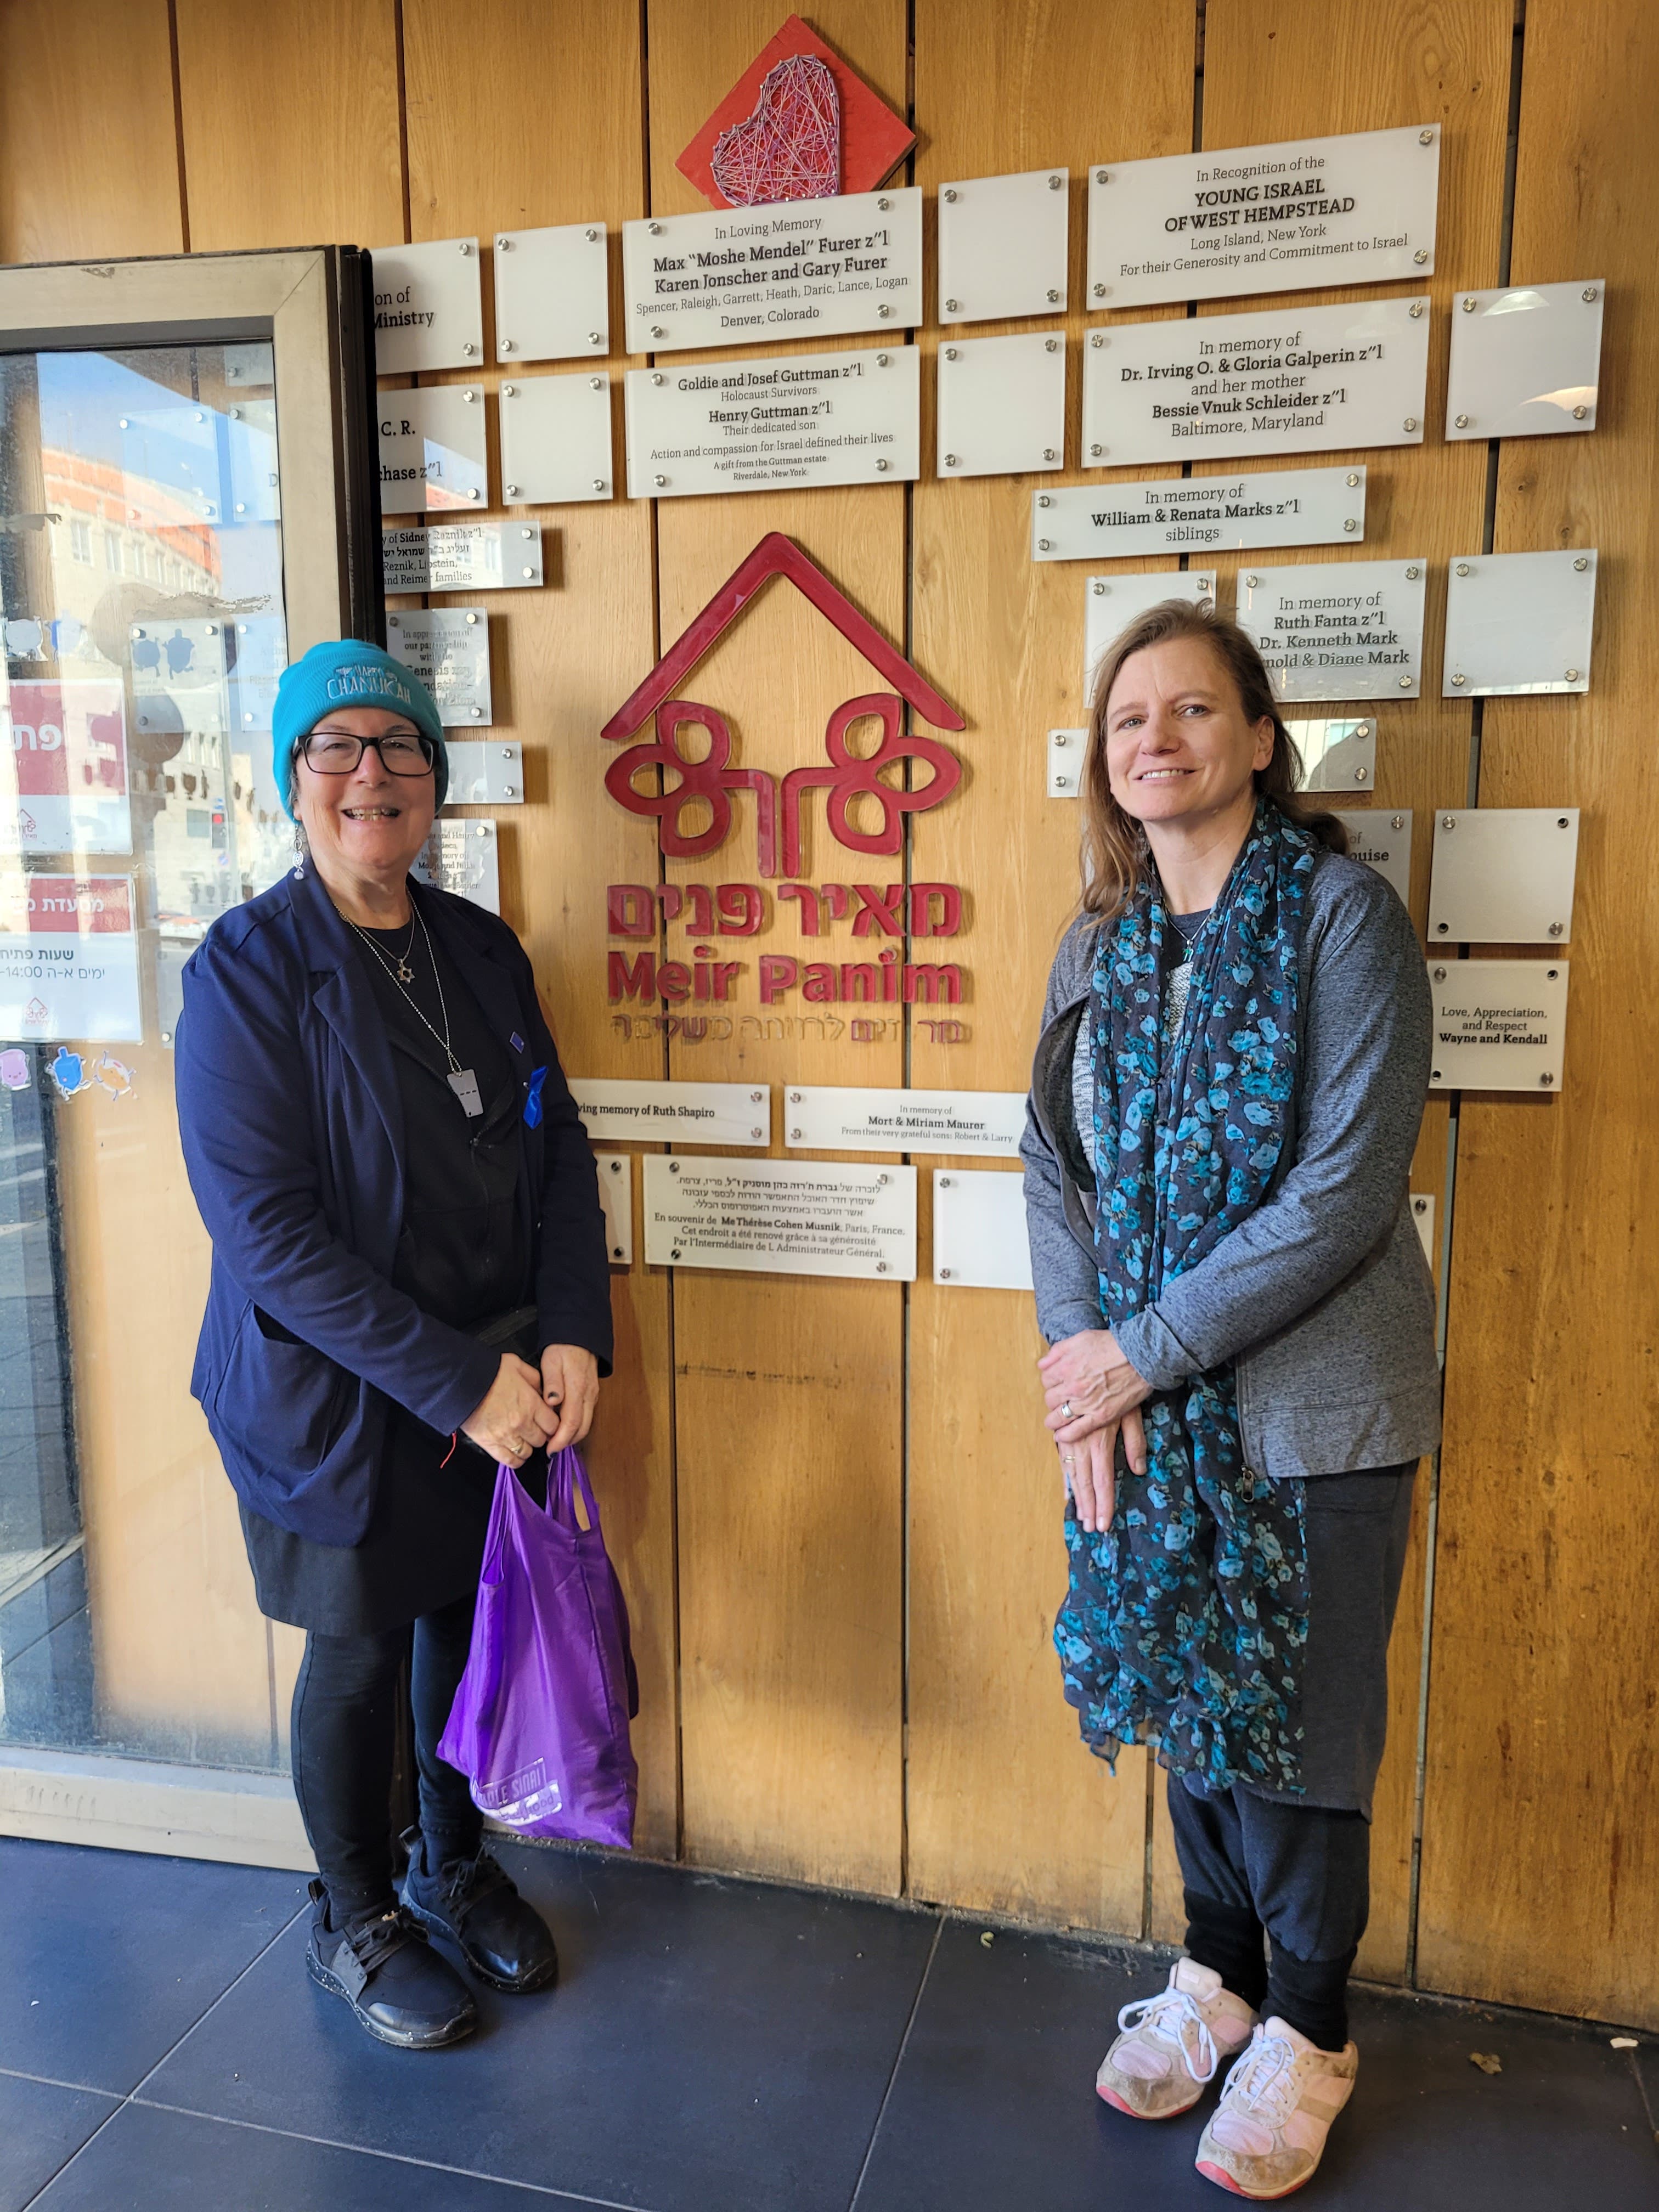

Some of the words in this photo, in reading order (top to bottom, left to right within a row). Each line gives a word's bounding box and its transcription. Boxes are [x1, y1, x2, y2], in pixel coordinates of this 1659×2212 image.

[1197, 170, 1209, 182] In
[1213, 160, 1286, 180] Recognition
[1290, 157, 1304, 170] of
[1305, 157, 1325, 169] the
[1195, 185, 1260, 207] YOUNG
[1263, 179, 1325, 199] ISRAEL
[1165, 216, 1189, 232] OF
[1191, 210, 1240, 229] WEST
[1243, 197, 1355, 223] HEMPSTEAD
[715, 227, 726, 239] In
[730, 223, 769, 238] Loving
[772, 218, 822, 233] Memory
[653, 257, 685, 272] Max
[819, 235, 861, 253] Furer
[1120, 264, 1139, 276] For
[1142, 260, 1171, 274] their
[1173, 253, 1240, 270] Generosity
[1244, 250, 1266, 263] and
[1269, 241, 1353, 260] Commitment
[1357, 240, 1369, 251] to
[1373, 234, 1408, 249] Israel
[655, 279, 699, 294] Karen
[703, 268, 768, 290] Jonscher
[771, 263, 799, 281] and
[803, 261, 840, 277] Gary
[844, 256, 887, 273] Furer
[397, 286, 410, 303] of
[721, 313, 765, 328] Denver,
[768, 307, 820, 323] Colorado
[1199, 341, 1214, 354] In
[1218, 335, 1282, 353] memory
[1286, 331, 1301, 347] of
[1121, 368, 1143, 381] Dr.
[1147, 362, 1194, 380] Irving
[1197, 361, 1214, 375] O.
[1218, 358, 1230, 372] &
[1233, 354, 1282, 371] Gloria
[1285, 348, 1355, 368] Galperin
[678, 376, 719, 391] Goldie
[722, 375, 744, 387] and
[748, 371, 778, 386] Josef
[781, 368, 839, 383] Guttman
[721, 389, 768, 402] Holocaust
[771, 386, 817, 398] Survivors
[709, 409, 748, 423] Henry
[751, 404, 808, 419] Guttman
[1152, 402, 1199, 419] Bessie
[1201, 398, 1242, 414] Vnuk
[1245, 393, 1318, 410] Schleider
[381, 421, 396, 436] C.
[400, 421, 415, 435] R.
[1171, 420, 1246, 437] Baltimore,
[1252, 411, 1324, 431] Maryland
[714, 461, 719, 470] A
[721, 459, 733, 470] gift
[736, 459, 753, 469] from
[756, 457, 768, 467] the
[769, 455, 802, 466] Guttman
[804, 454, 826, 464] estate
[379, 466, 416, 482] chase
[733, 470, 770, 481] Riverdale,
[772, 469, 788, 478] New
[790, 467, 806, 477] York
[1091, 511, 1151, 527] William
[1154, 509, 1166, 522] &
[1170, 508, 1221, 522] Renata
[1224, 504, 1272, 518] Marks
[390, 533, 398, 543] of
[1166, 527, 1220, 542] siblings
[384, 561, 416, 571] Reznik,
[435, 571, 472, 582] families
[1274, 615, 1310, 629] Ruth
[1314, 614, 1357, 628] Fanta
[1260, 637, 1281, 650] Dr.
[1286, 633, 1352, 648] Kenneth
[1356, 631, 1398, 645] Mark
[1265, 654, 1298, 668] nold
[1302, 653, 1314, 666] &
[1318, 653, 1363, 666] Diane
[1368, 650, 1409, 663] Mark
[355, 665, 381, 676] HAPPY
[328, 676, 411, 704] CHANUKAH
[1350, 832, 1362, 844] of
[1350, 849, 1389, 861] ouise
[607, 883, 764, 936] פנים
[778, 883, 962, 936] מאיר
[38, 950, 74, 960] שעות
[78, 968, 105, 979] ימים
[608, 945, 738, 1002] Meir
[759, 947, 962, 1004] Panim
[1442, 1007, 1470, 1017] Love,
[1473, 1007, 1548, 1019] Appreciation,
[1462, 1020, 1482, 1030] and
[1485, 1021, 1527, 1032] Respect
[1440, 1033, 1477, 1045] Wayne
[1480, 1034, 1500, 1043] and
[1503, 1034, 1548, 1044] Kendall
[578, 1103, 597, 1115] ving
[600, 1105, 640, 1117] memory
[641, 1104, 651, 1115] of
[653, 1105, 676, 1116] Ruth
[678, 1107, 715, 1120] Shapiro
[910, 1106, 943, 1115] memory
[868, 1116, 893, 1126] Mort
[896, 1117, 903, 1126] &
[906, 1118, 944, 1128] Miriam
[947, 1119, 985, 1130] Maurer
[842, 1127, 861, 1136] From
[862, 1127, 880, 1136] their
[882, 1130, 899, 1138] very
[901, 1130, 930, 1140] grateful
[991, 1133, 1013, 1143] Larry
[654, 1212, 665, 1222] En
[668, 1216, 704, 1224] souvenir
[707, 1216, 716, 1224] de
[721, 1216, 735, 1226] Me
[774, 1220, 803, 1229] Cohen
[805, 1221, 843, 1232] Musnik,
[845, 1223, 870, 1234] Paris,
